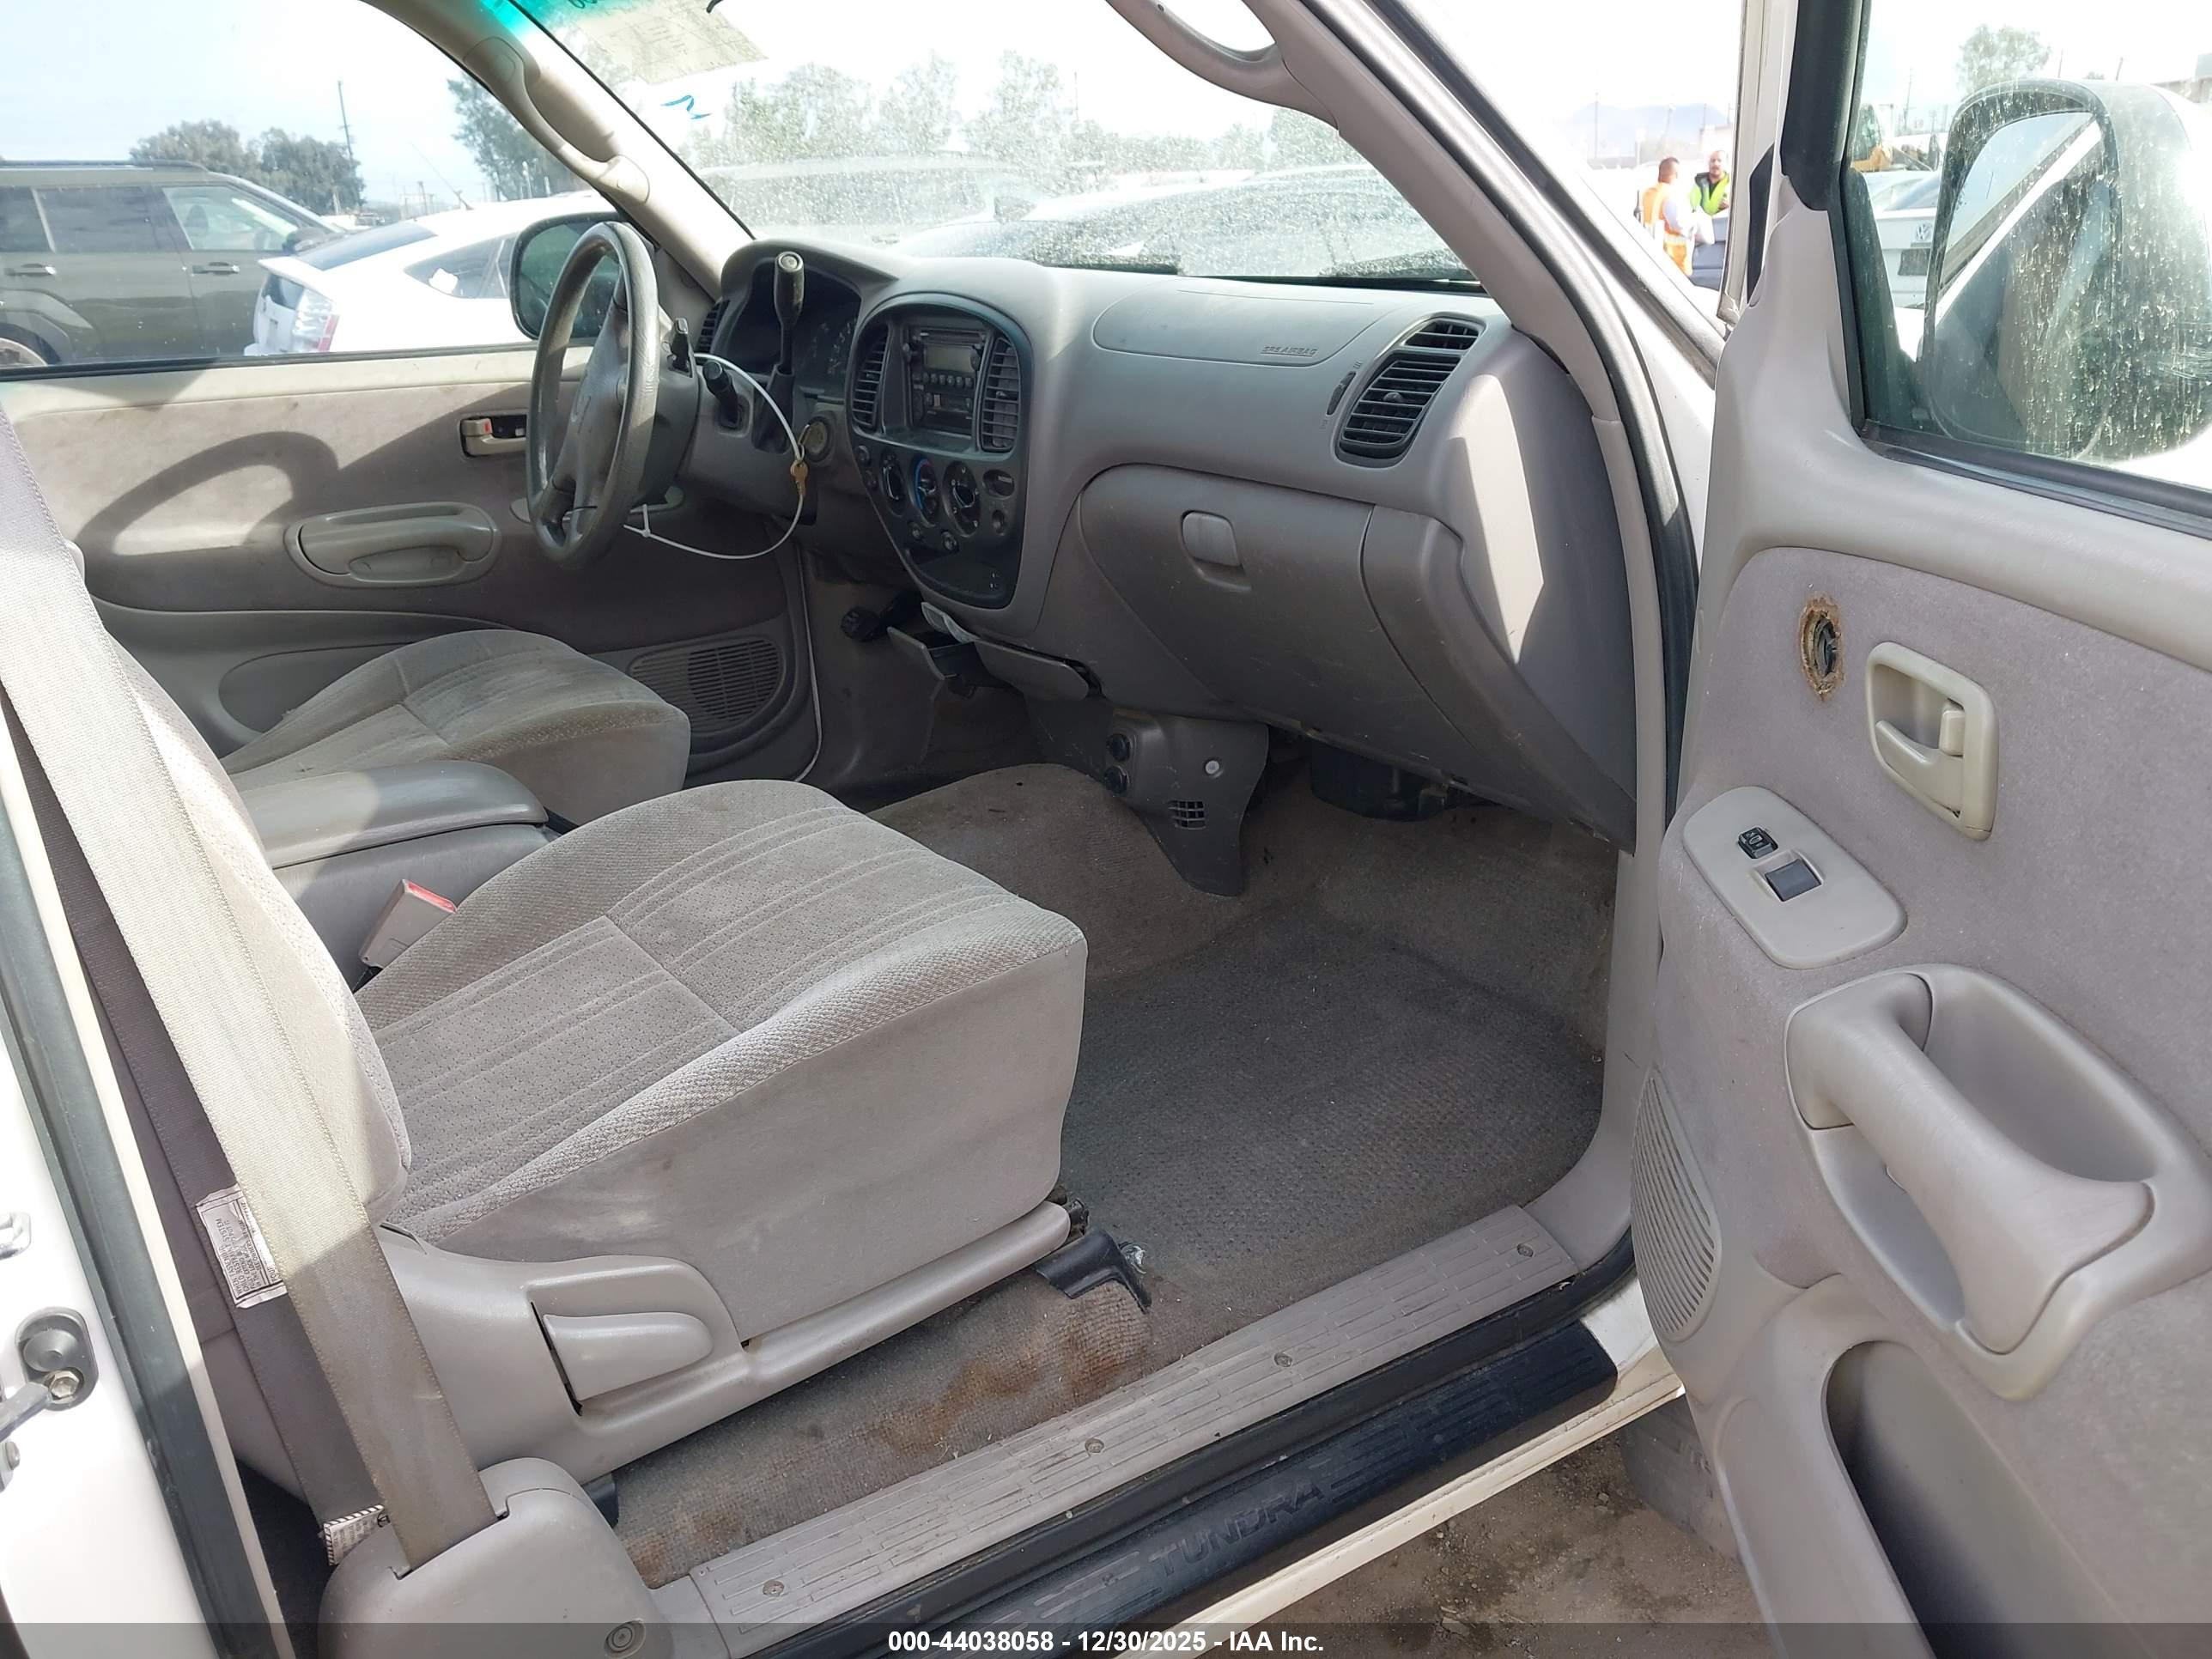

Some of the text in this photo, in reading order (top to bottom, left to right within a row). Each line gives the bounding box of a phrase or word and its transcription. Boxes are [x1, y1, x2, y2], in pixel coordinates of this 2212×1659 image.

[1281, 346, 1318, 356] AIRBAG
[215, 1218, 230, 1243] SYSTEM
[246, 1259, 255, 1272] LOCK
[231, 1278, 243, 1295] WHEN
[238, 1274, 250, 1292] CHILD
[1149, 1483, 1325, 1577] TUNDRA
